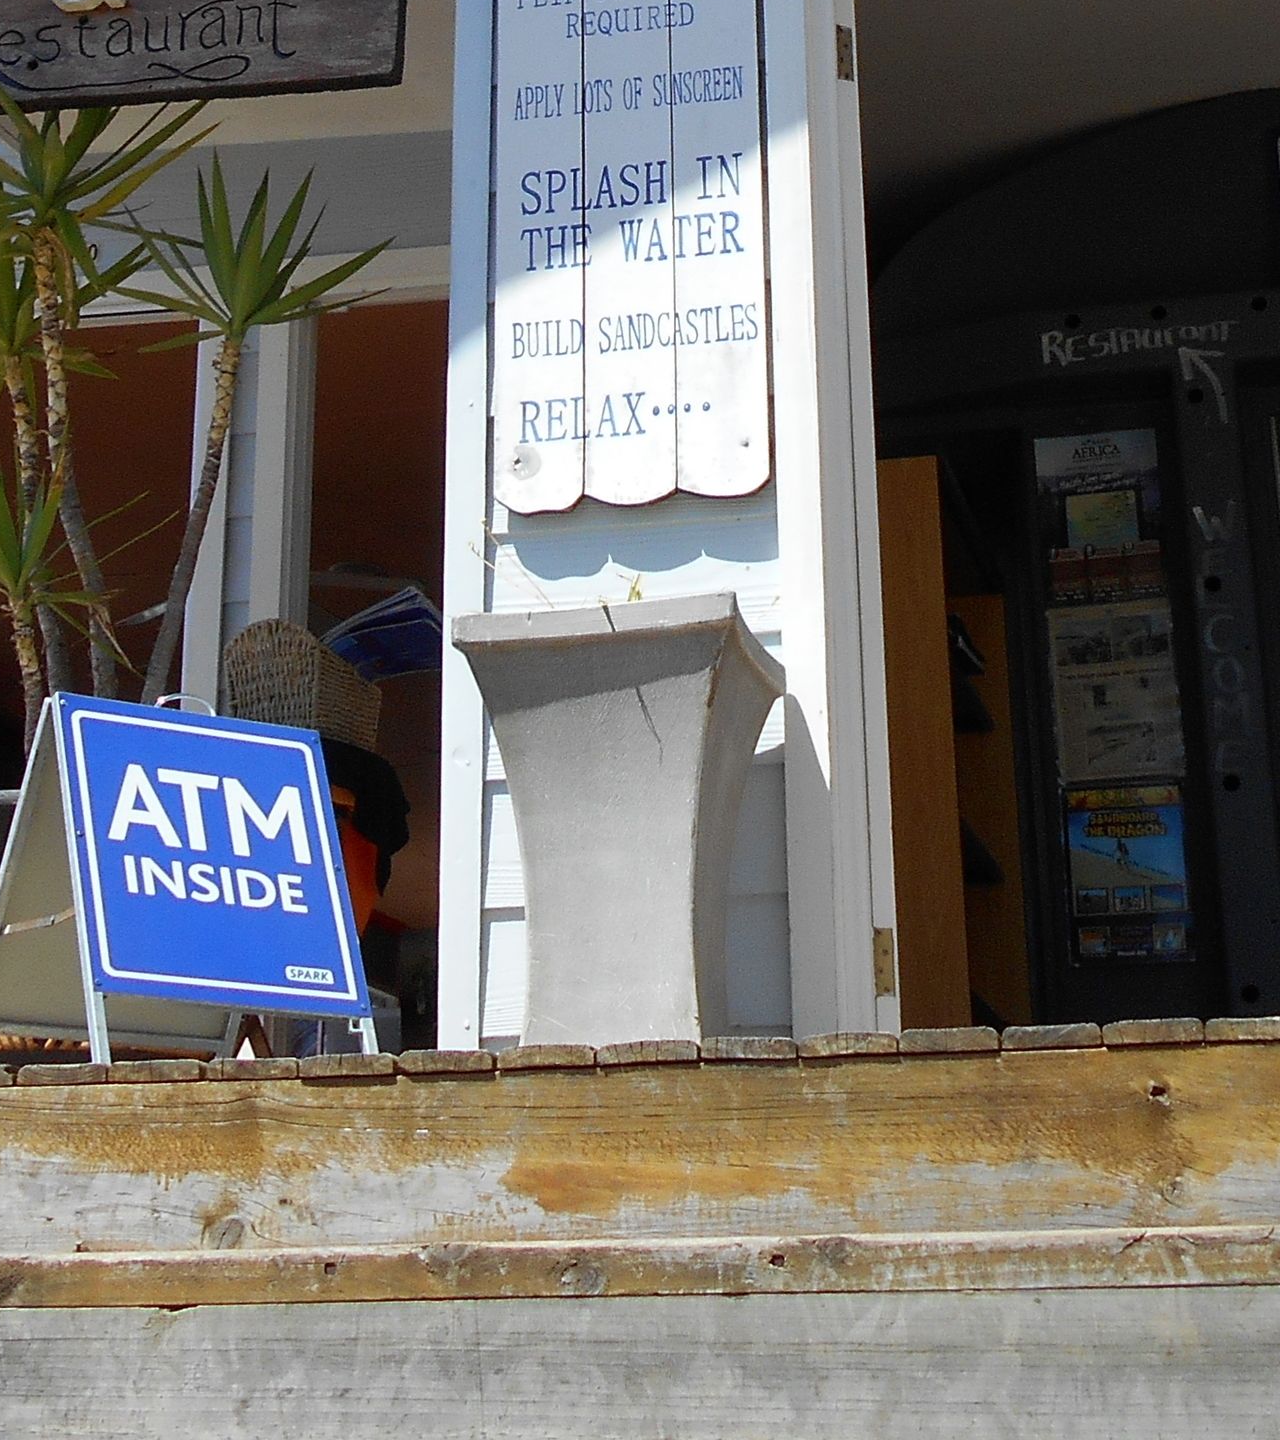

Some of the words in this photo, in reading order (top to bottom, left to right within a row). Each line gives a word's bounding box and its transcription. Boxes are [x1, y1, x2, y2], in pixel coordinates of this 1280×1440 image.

[566, 1, 695, 39] REQUIRED
[514, 81, 565, 121] APPLY
[573, 78, 613, 116] LOTS
[623, 76, 644, 110] OF
[653, 66, 744, 107] SUNSCREEN
[520, 159, 668, 216] SPLASH
[695, 151, 743, 200] IN
[520, 222, 593, 272] THE
[619, 210, 745, 262] WATER
[511, 317, 584, 360] BUILD
[598, 302, 760, 355] SANDCASTLES
[1072, 444, 1120, 460] AFRICA
[107, 763, 312, 865] ATM
[122, 855, 308, 914] INSIDE
[289, 968, 329, 982] SPARK
